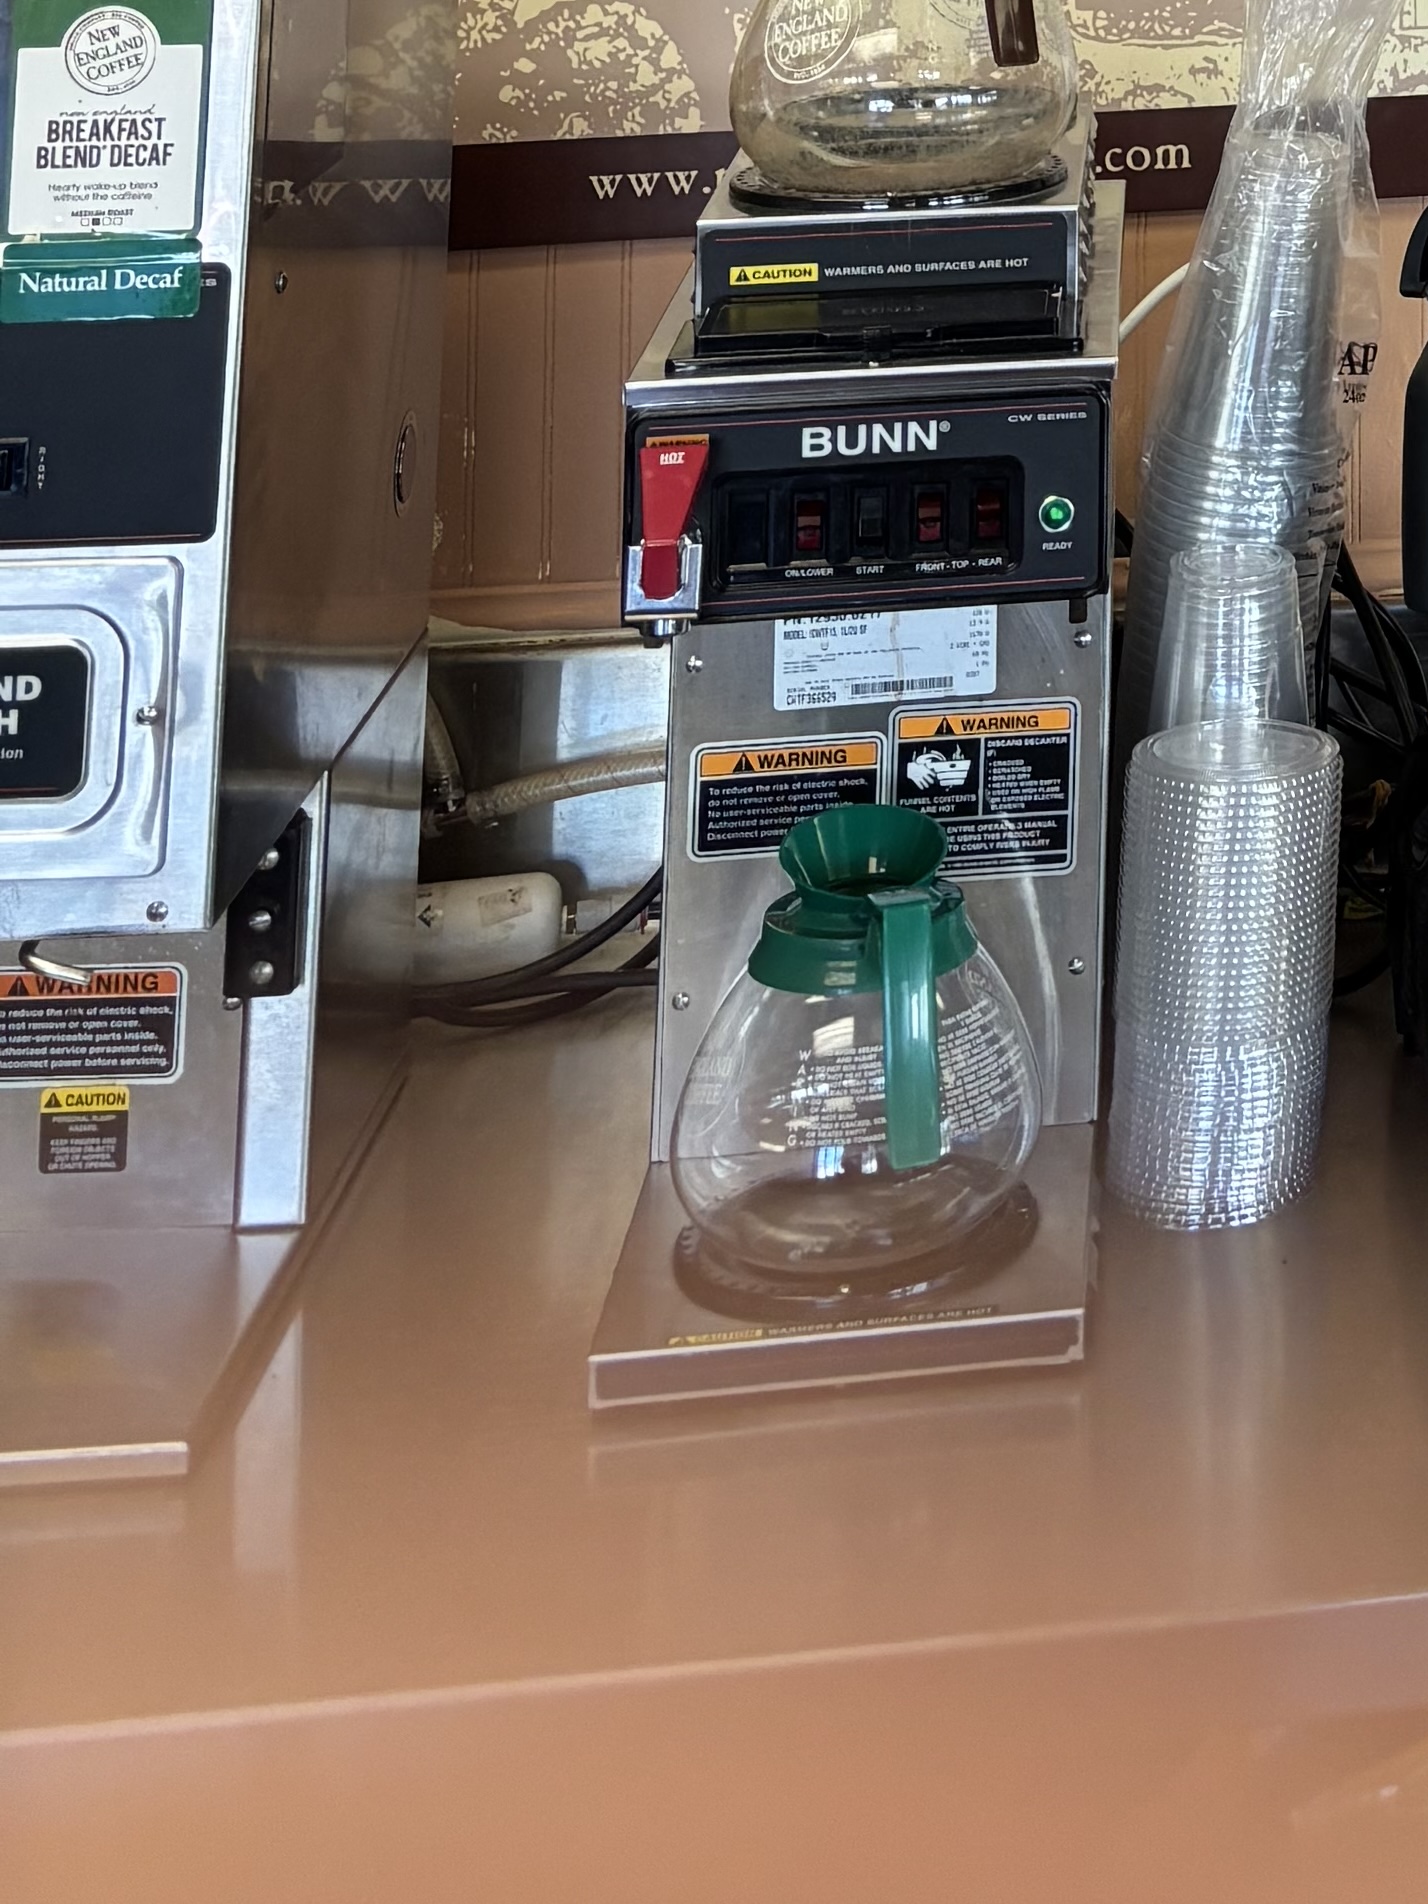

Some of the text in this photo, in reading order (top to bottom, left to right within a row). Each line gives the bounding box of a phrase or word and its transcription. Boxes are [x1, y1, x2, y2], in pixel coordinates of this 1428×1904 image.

[88, 24, 121, 45] NEW
[774, 4, 848, 43] ENGLAND
[76, 36, 144, 67] ENGLAND
[778, 27, 841, 62] COFFEE
[87, 54, 144, 80] COFFEE
[47, 118, 166, 142] BREAKFAST
[110, 144, 174, 167] DECAF
[752, 257, 1029, 280] CAUTION WARMERS AND SURFACES ARE HOT
[20, 267, 183, 294] Natural Decaf
[1007, 411, 1088, 423] CW SERIES
[802, 421, 938, 458] BUNN
[1042, 542, 1072, 550] READY
[856, 566, 884, 574] START
[916, 557, 1002, 572] FRONT TOP REAR
[961, 715, 1039, 731] WARNING
[757, 749, 847, 769] WARNING
[66, 1093, 126, 1106] CAUTION
